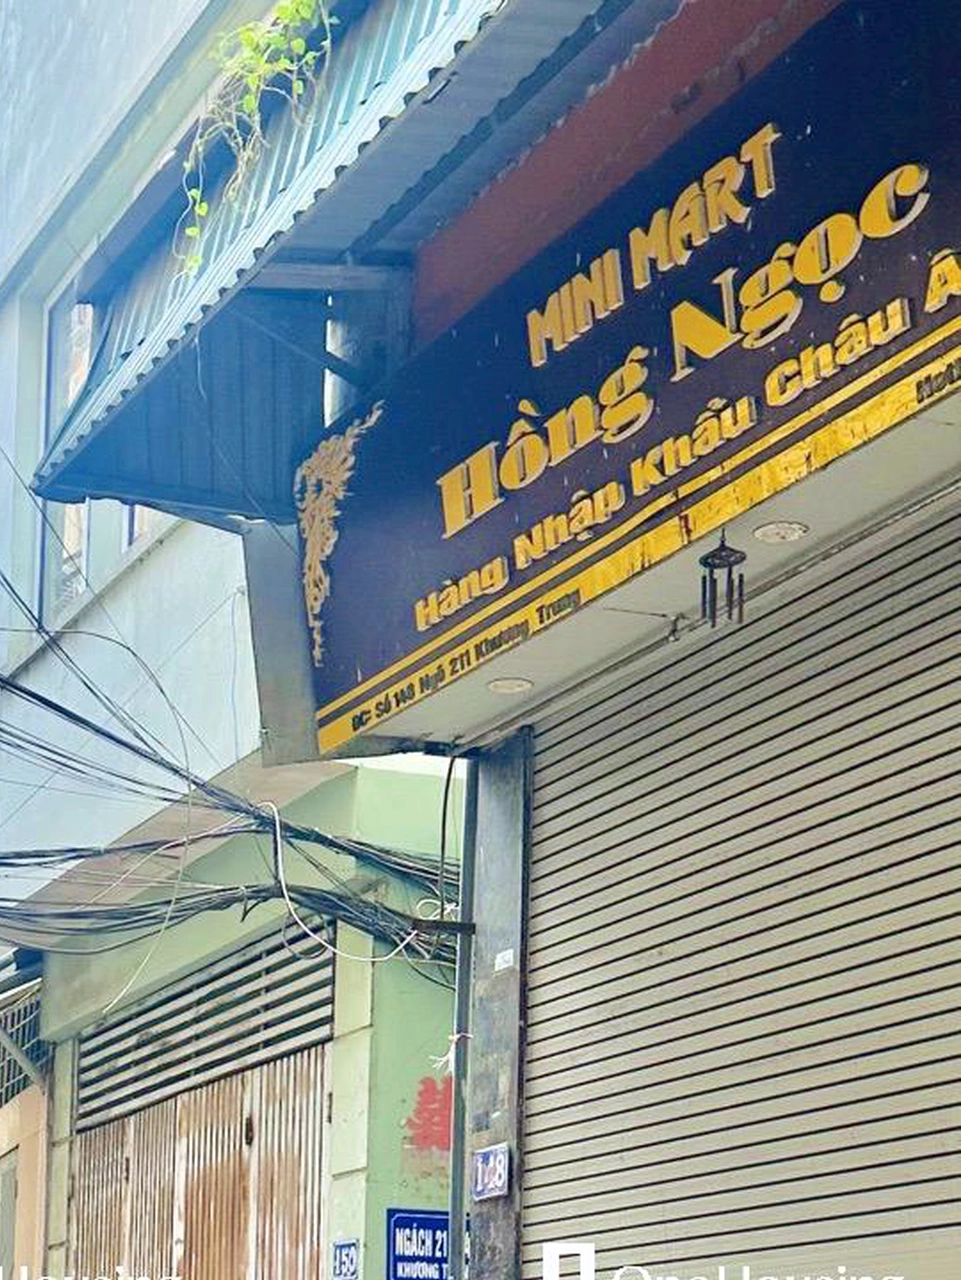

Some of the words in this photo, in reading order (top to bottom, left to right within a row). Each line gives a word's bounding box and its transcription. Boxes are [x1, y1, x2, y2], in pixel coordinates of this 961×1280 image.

[527, 248, 624, 368] MINI
[629, 123, 782, 290] MART
[436, 345, 654, 540] Hồng
[669, 163, 931, 383] Ngọc
[414, 555, 509, 632] Hàng
[513, 481, 625, 570] Nhập
[629, 396, 757, 497] Khẩu
[764, 297, 911, 407] Châu
[449, 648, 471, 677] 211
[395, 1222, 433, 1257] NGÁCH
[335, 1246, 357, 1276] 150
[397, 1261, 440, 1280] KHƯƠNG
